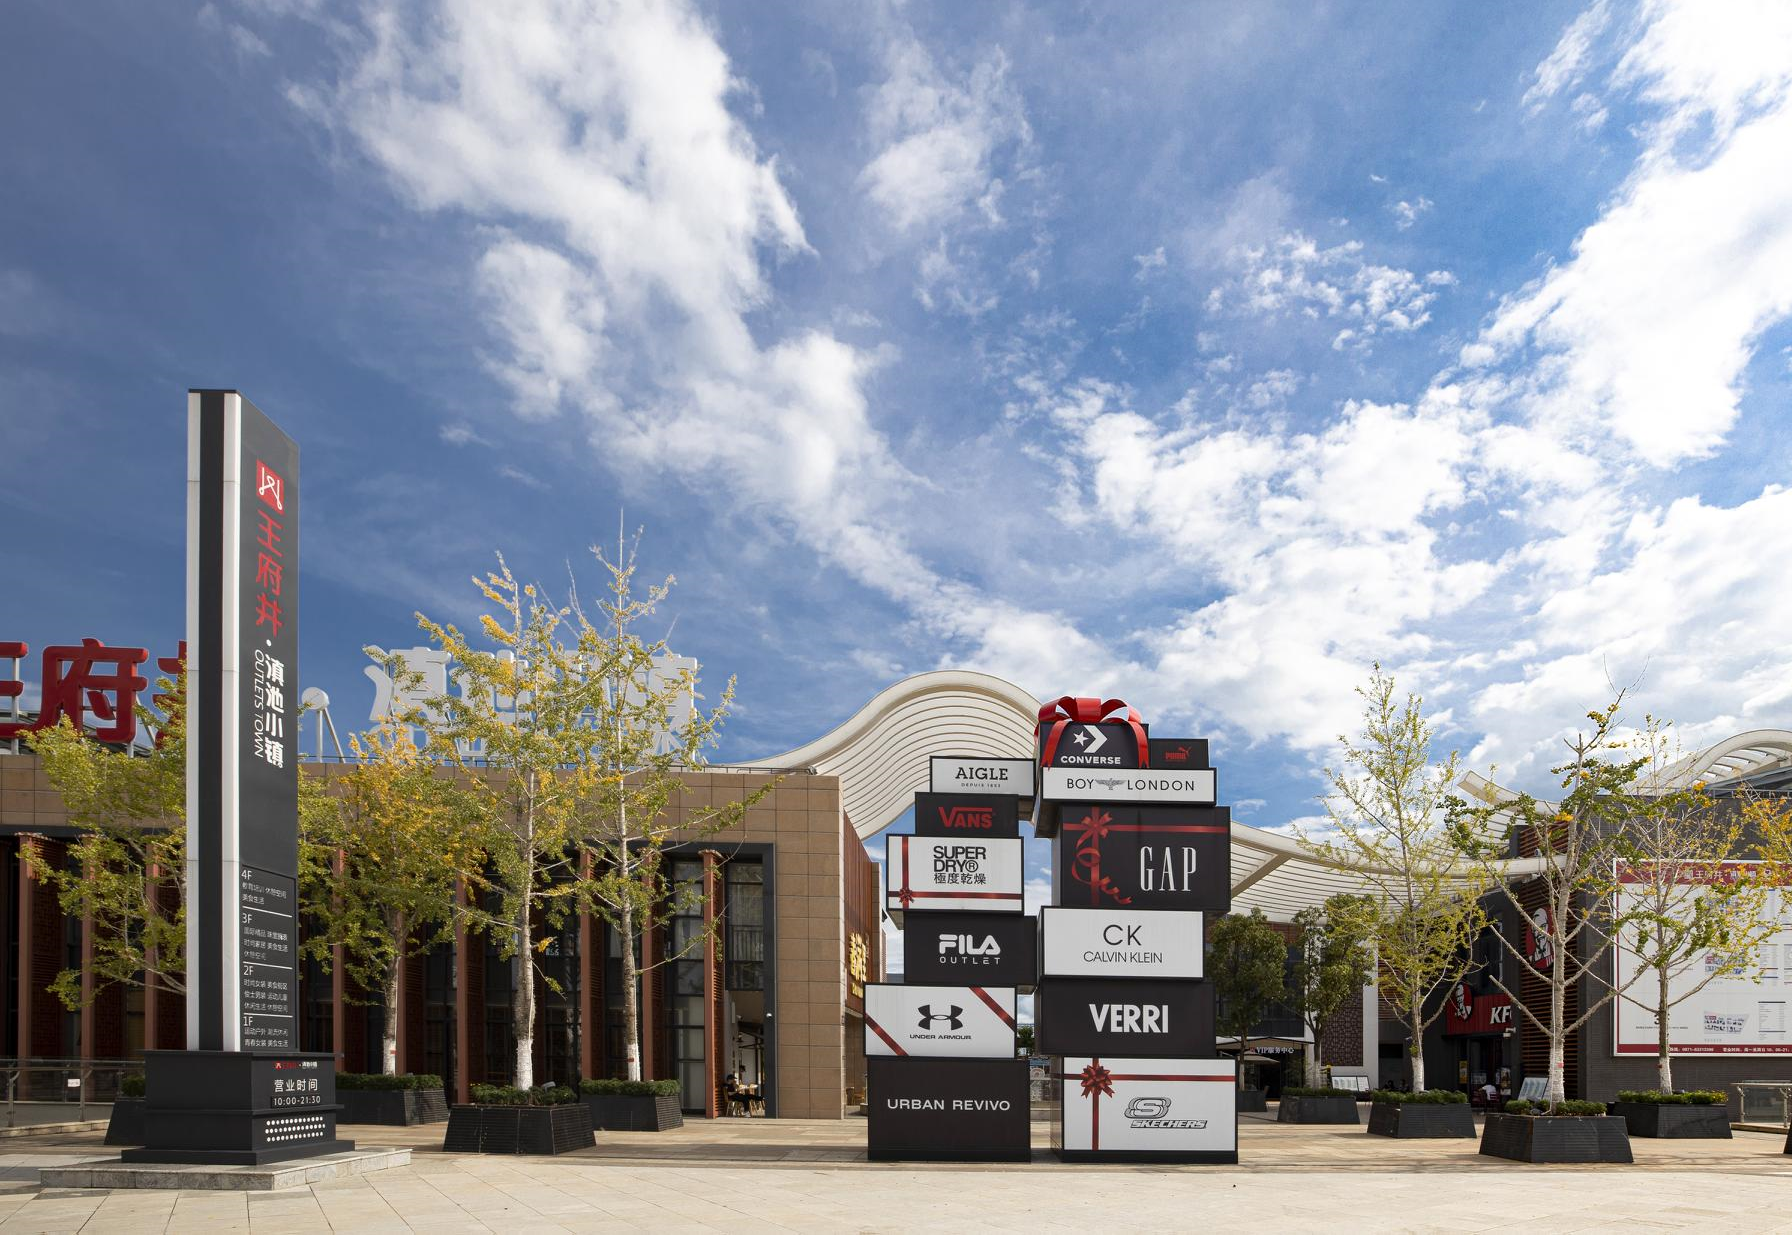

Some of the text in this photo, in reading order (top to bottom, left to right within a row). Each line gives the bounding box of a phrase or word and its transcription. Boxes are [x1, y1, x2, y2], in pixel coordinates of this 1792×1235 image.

[255, 649, 264, 758] OUTLETS TOWN
[1060, 755, 1121, 765] CONVERSE
[955, 767, 1008, 781] AIGLE
[1066, 778, 1195, 791] BOY LONDON
[938, 807, 993, 829] VANS
[933, 846, 987, 859] SUPER
[241, 870, 252, 880] 4F
[1140, 846, 1197, 892] GAP
[933, 873, 987, 885] 極度乾燥
[242, 913, 253, 924] 3F
[1103, 924, 1142, 946] CK
[939, 934, 1001, 955] FILA
[939, 956, 1001, 965] OUTLET
[1083, 951, 1163, 963] CALVIN KLEIN
[243, 965, 254, 976] 2F
[243, 1016, 254, 1026] 1F
[1089, 1004, 1169, 1033] VERRI
[1490, 1005, 1512, 1024] KF
[274, 1079, 318, 1092] 营业时间
[887, 1099, 1011, 1111] URBAN REVIVO
[1130, 1119, 1208, 1130] SKECHERS
